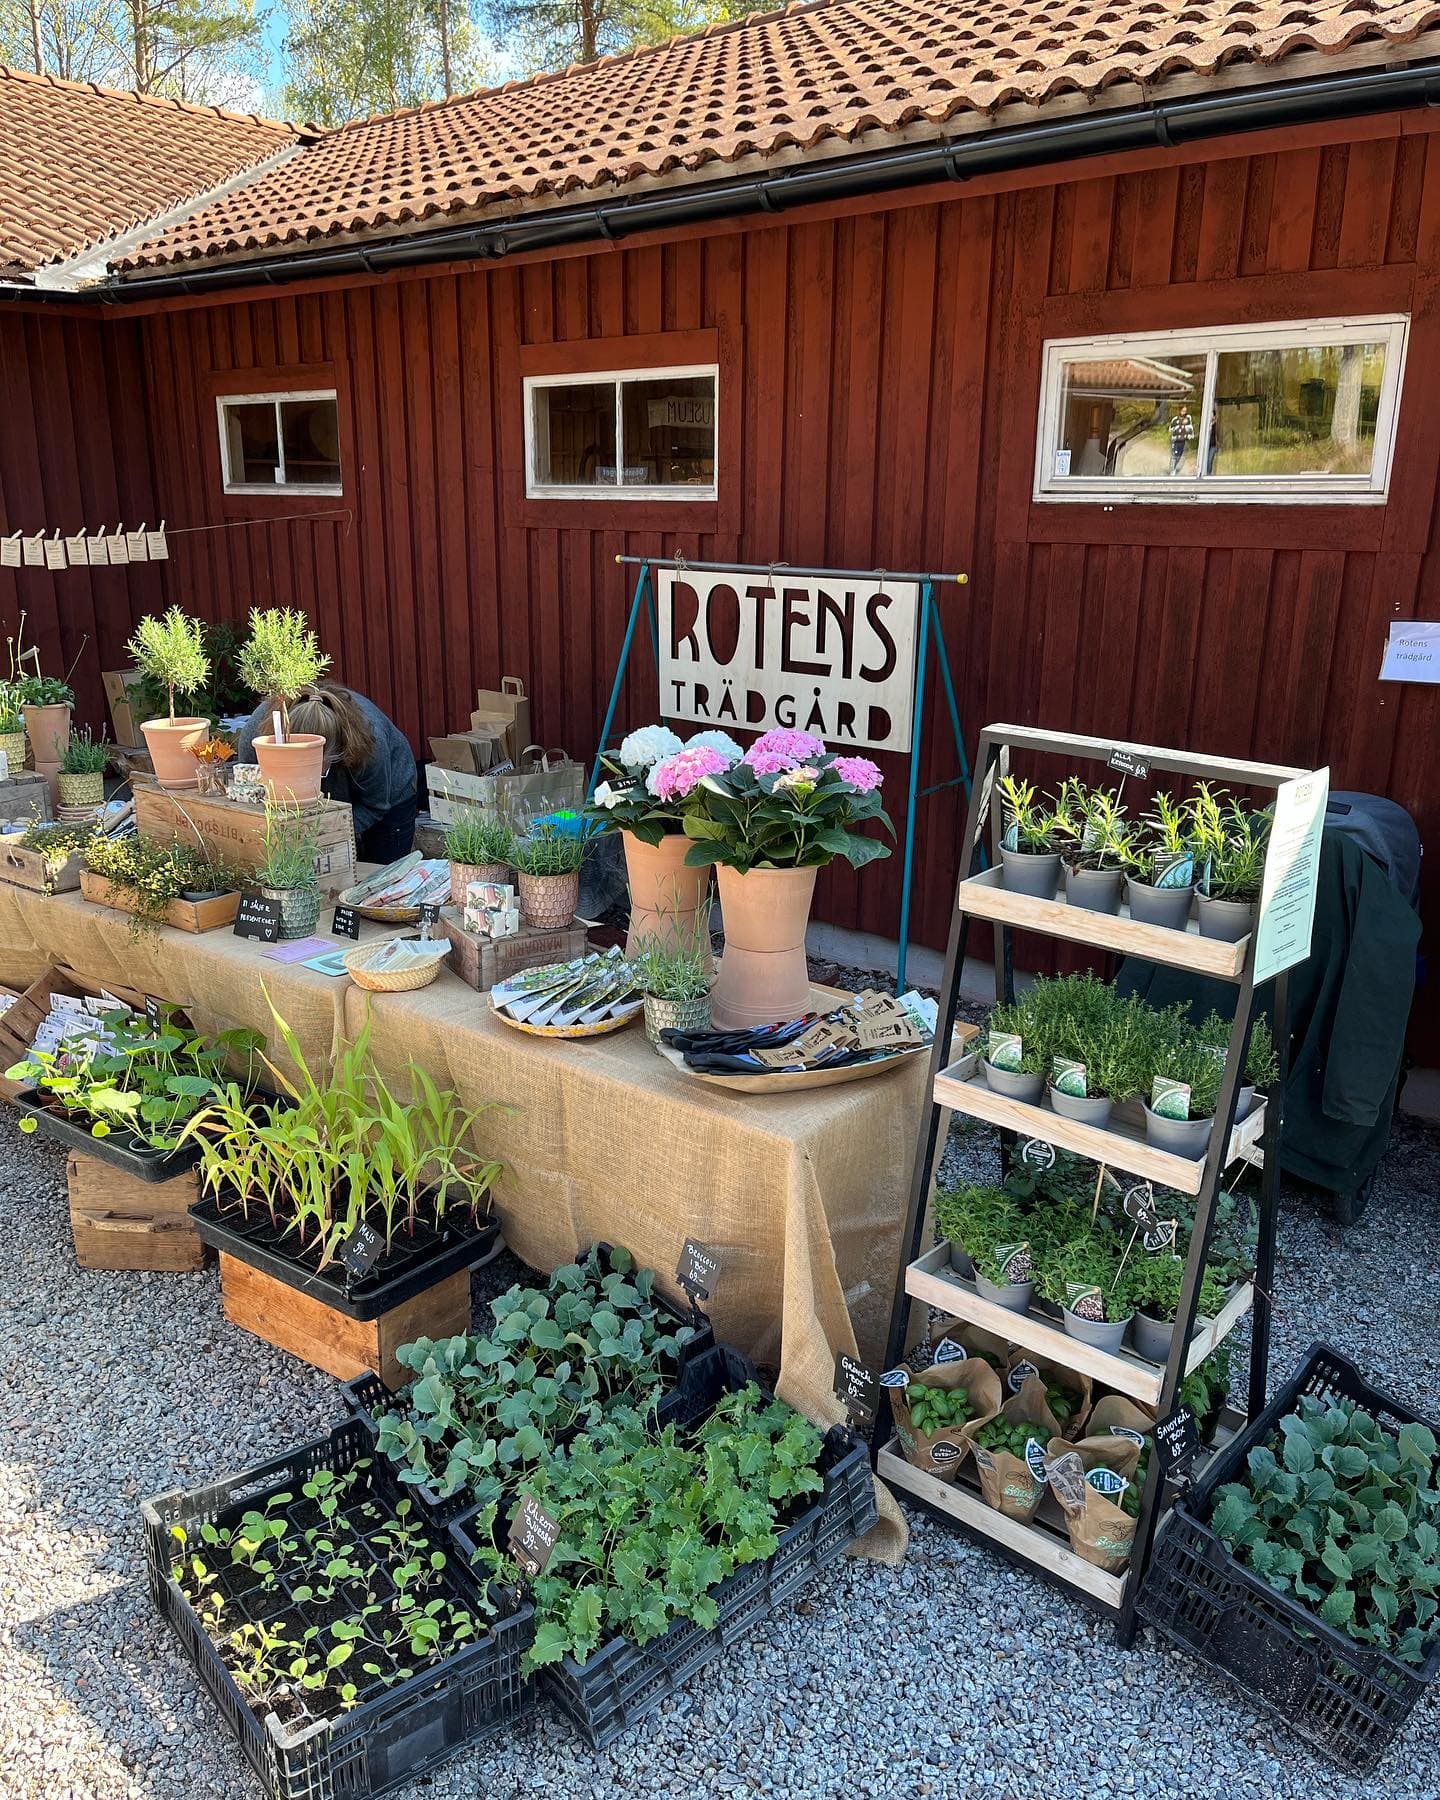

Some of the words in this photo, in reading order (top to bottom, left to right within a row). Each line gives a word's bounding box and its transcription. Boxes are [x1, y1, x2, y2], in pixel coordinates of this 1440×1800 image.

[671, 579, 897, 683] ROTENS
[1399, 639, 1428, 648] Rotens
[1396, 653, 1433, 662] trädgård
[671, 678, 892, 742] TRÄDGÅRD
[1113, 751, 1132, 762] ALLA
[686, 1244, 717, 1271] BROCCOLI
[694, 1260, 708, 1275] BOX
[848, 1373, 865, 1388] BOX
[1157, 1408, 1191, 1440] SAVOYKÅL
[1169, 1426, 1186, 1442] BOX
[526, 1499, 555, 1532] KÅLROT
